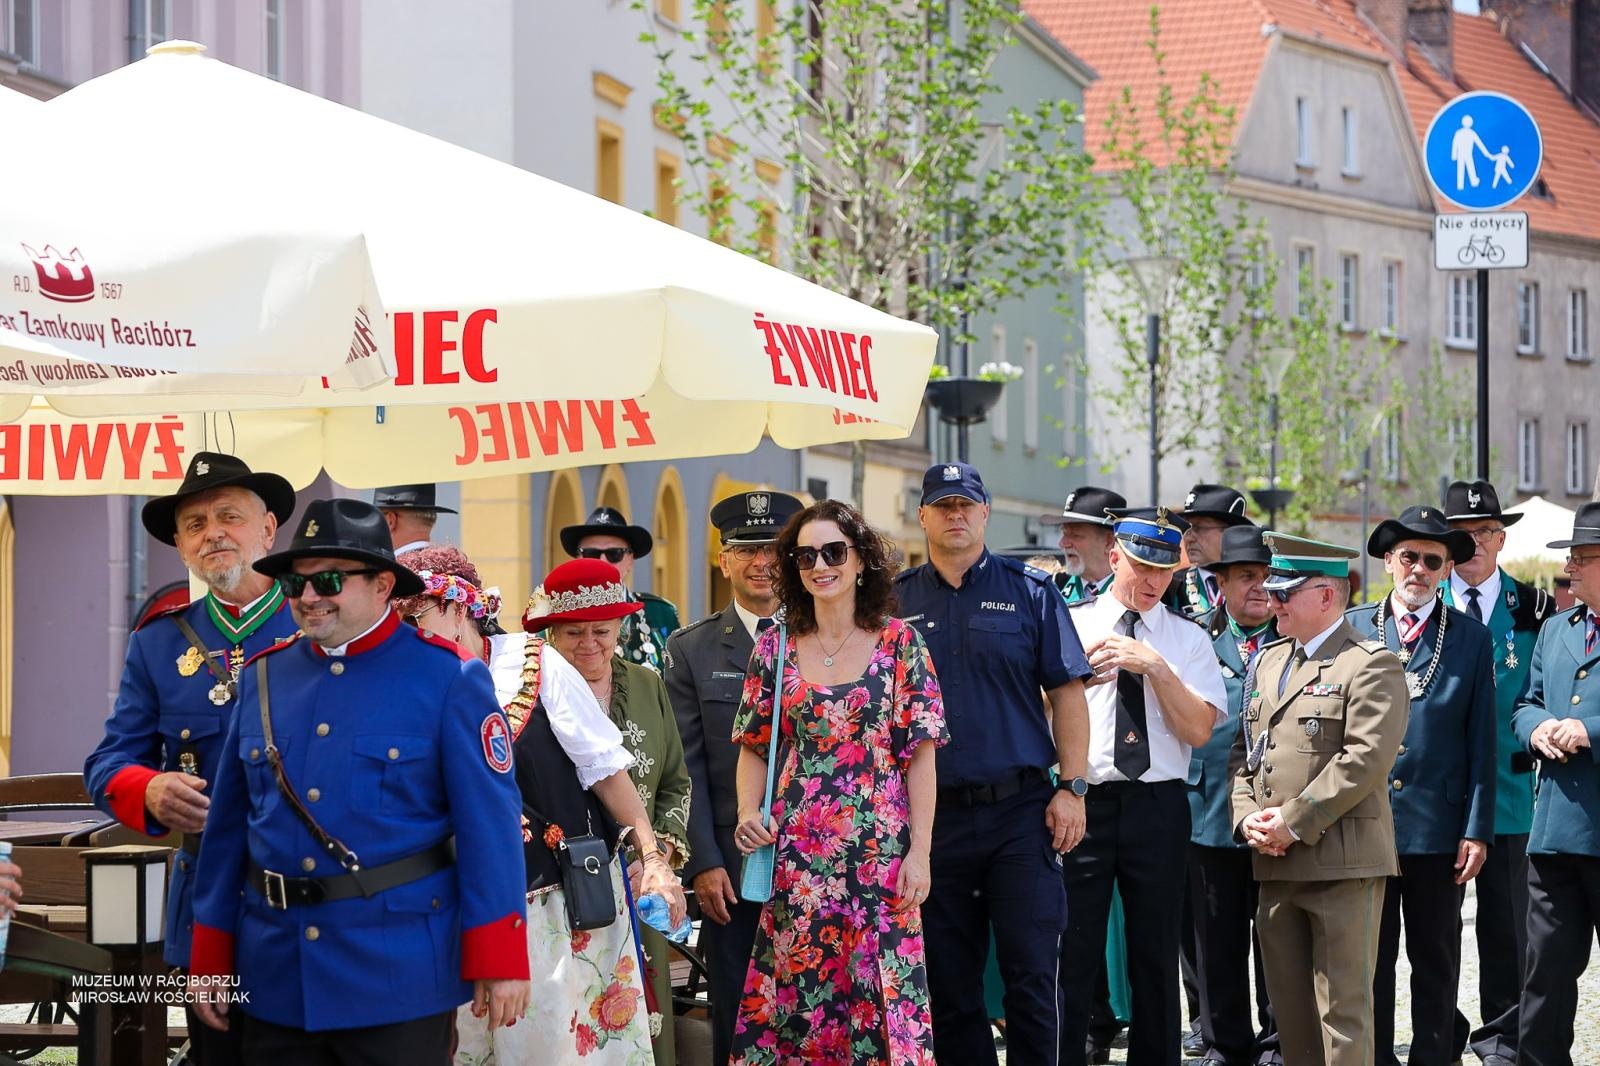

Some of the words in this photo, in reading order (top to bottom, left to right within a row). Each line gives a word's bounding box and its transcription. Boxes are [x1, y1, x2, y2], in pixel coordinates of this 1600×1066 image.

[1439, 218, 1463, 229] Nie
[1470, 216, 1524, 231] dotyczy
[14, 275, 32, 292] A.D.
[100, 283, 123, 299] 1567
[19, 310, 105, 348] Zamkowy
[111, 318, 196, 347] Racibórz
[386, 309, 498, 386] IEC
[753, 312, 878, 403] ŻYWIEC
[981, 601, 1015, 612] POLICJA
